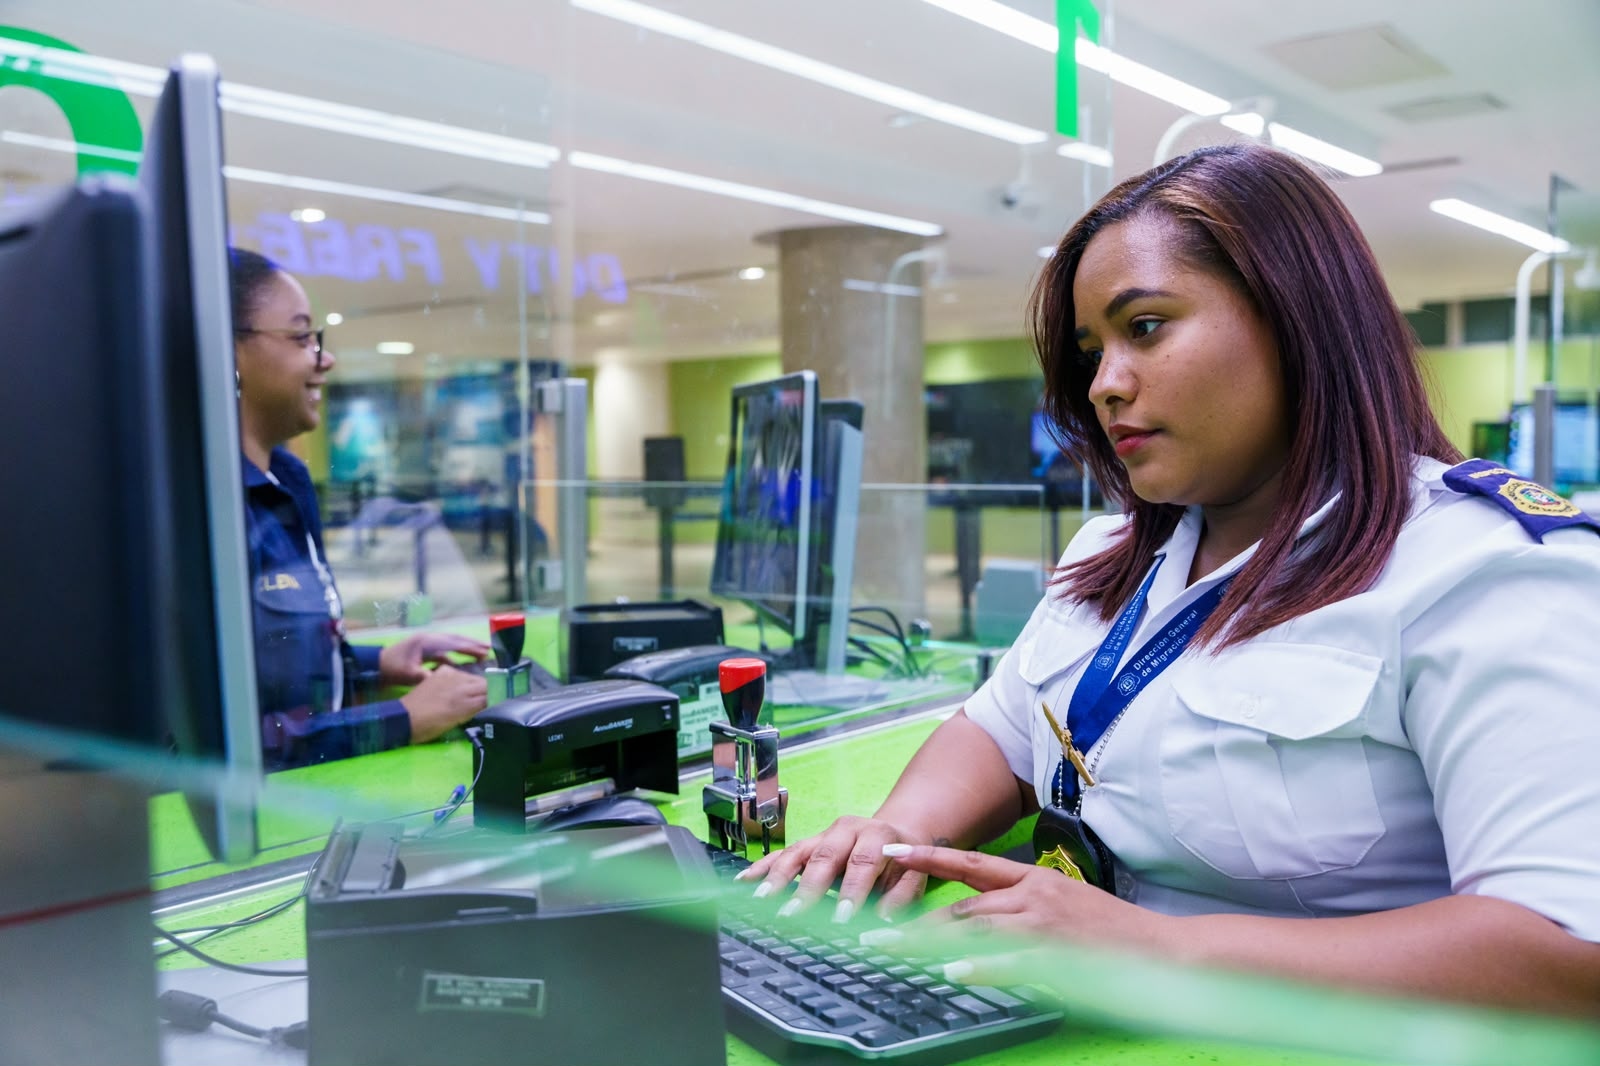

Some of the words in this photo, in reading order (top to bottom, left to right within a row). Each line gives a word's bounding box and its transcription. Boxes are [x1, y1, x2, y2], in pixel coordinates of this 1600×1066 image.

[1133, 636, 1170, 671] Dirección
[1167, 609, 1198, 638] General
[1141, 666, 1152, 677] de
[1150, 633, 1189, 668] Migración
